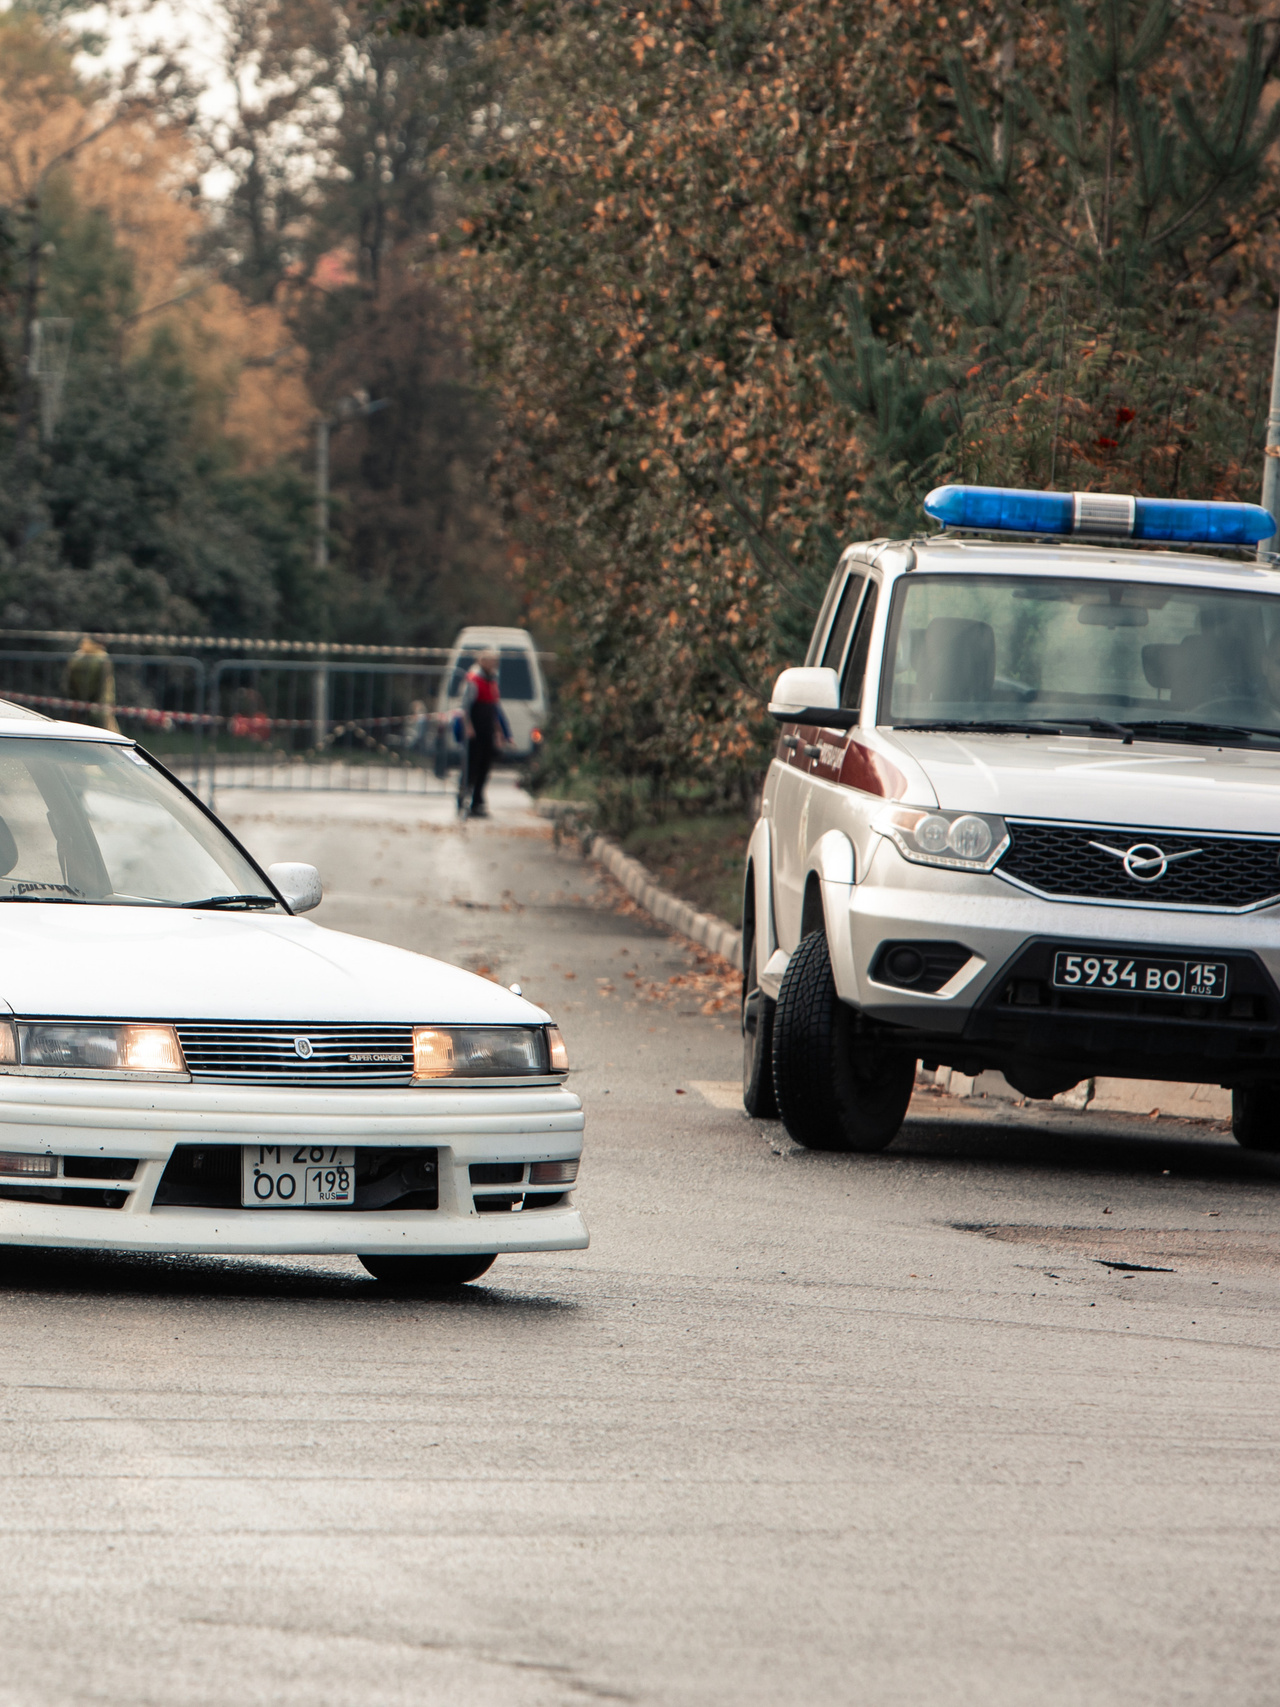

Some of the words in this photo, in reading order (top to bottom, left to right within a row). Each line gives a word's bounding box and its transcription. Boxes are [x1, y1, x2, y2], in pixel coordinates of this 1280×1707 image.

[1064, 956, 1138, 989] 5934
[1190, 964, 1217, 986] 15
[1191, 985, 1212, 995] RUS
[349, 1054, 372, 1062] SUPER
[373, 1054, 404, 1062] CHARGER
[312, 1170, 350, 1192] 198
[320, 1192, 336, 1200] RUS
